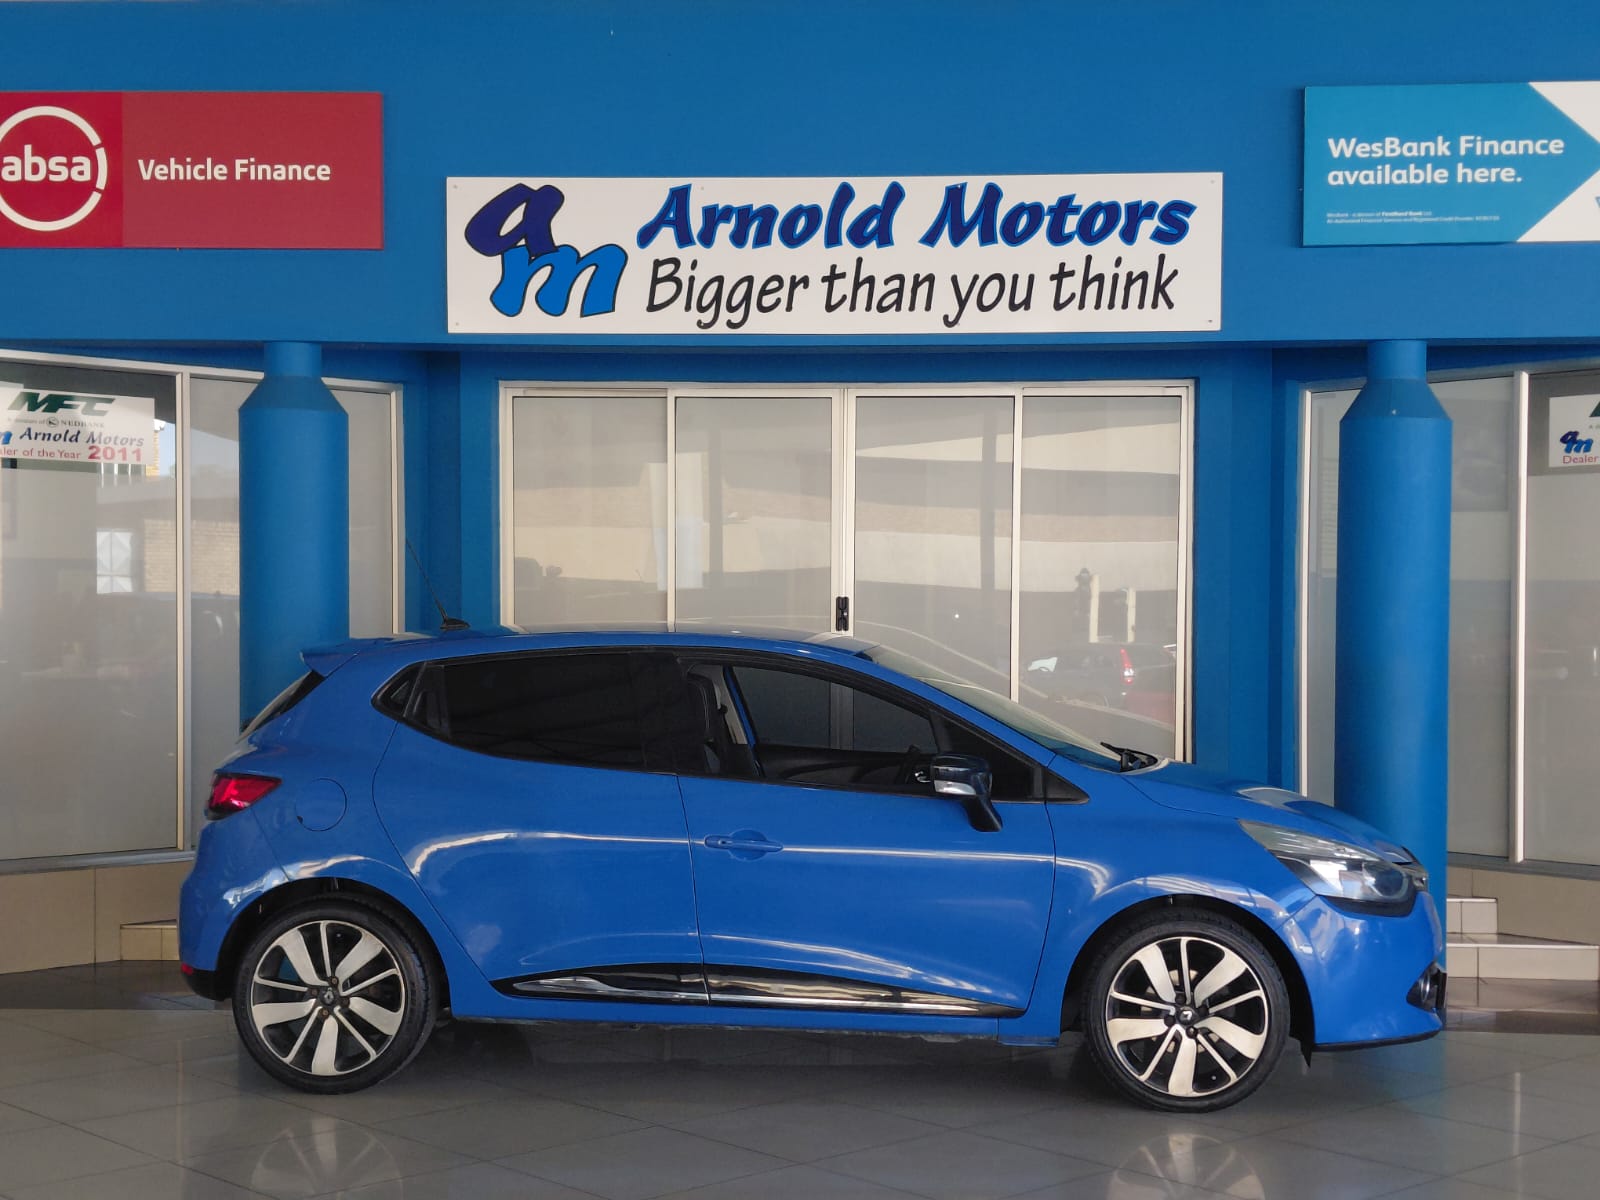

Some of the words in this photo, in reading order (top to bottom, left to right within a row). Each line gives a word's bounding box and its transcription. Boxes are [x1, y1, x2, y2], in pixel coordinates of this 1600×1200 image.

[1327, 136, 1451, 158] WesBank
[1459, 135, 1564, 156] Finance
[1, 144, 91, 182] absa
[138, 157, 228, 181] Vehicle
[234, 157, 331, 181] Finance
[1327, 163, 1449, 186] available
[1456, 163, 1523, 183] here.
[636, 181, 906, 249] Arnold
[918, 182, 1197, 247] Motors
[646, 256, 809, 330] Bigger
[820, 256, 935, 314] than
[942, 272, 1035, 328] you
[1049, 253, 1179, 312] think
[8, 391, 115, 416] MFC
[19, 426, 81, 443] Arnold
[86, 431, 145, 447] Motors
[22, 447, 34, 457] of
[37, 447, 56, 458] the
[57, 449, 81, 460] Year
[88, 445, 142, 462] 2011
[1562, 455, 1599, 464] Dealer
